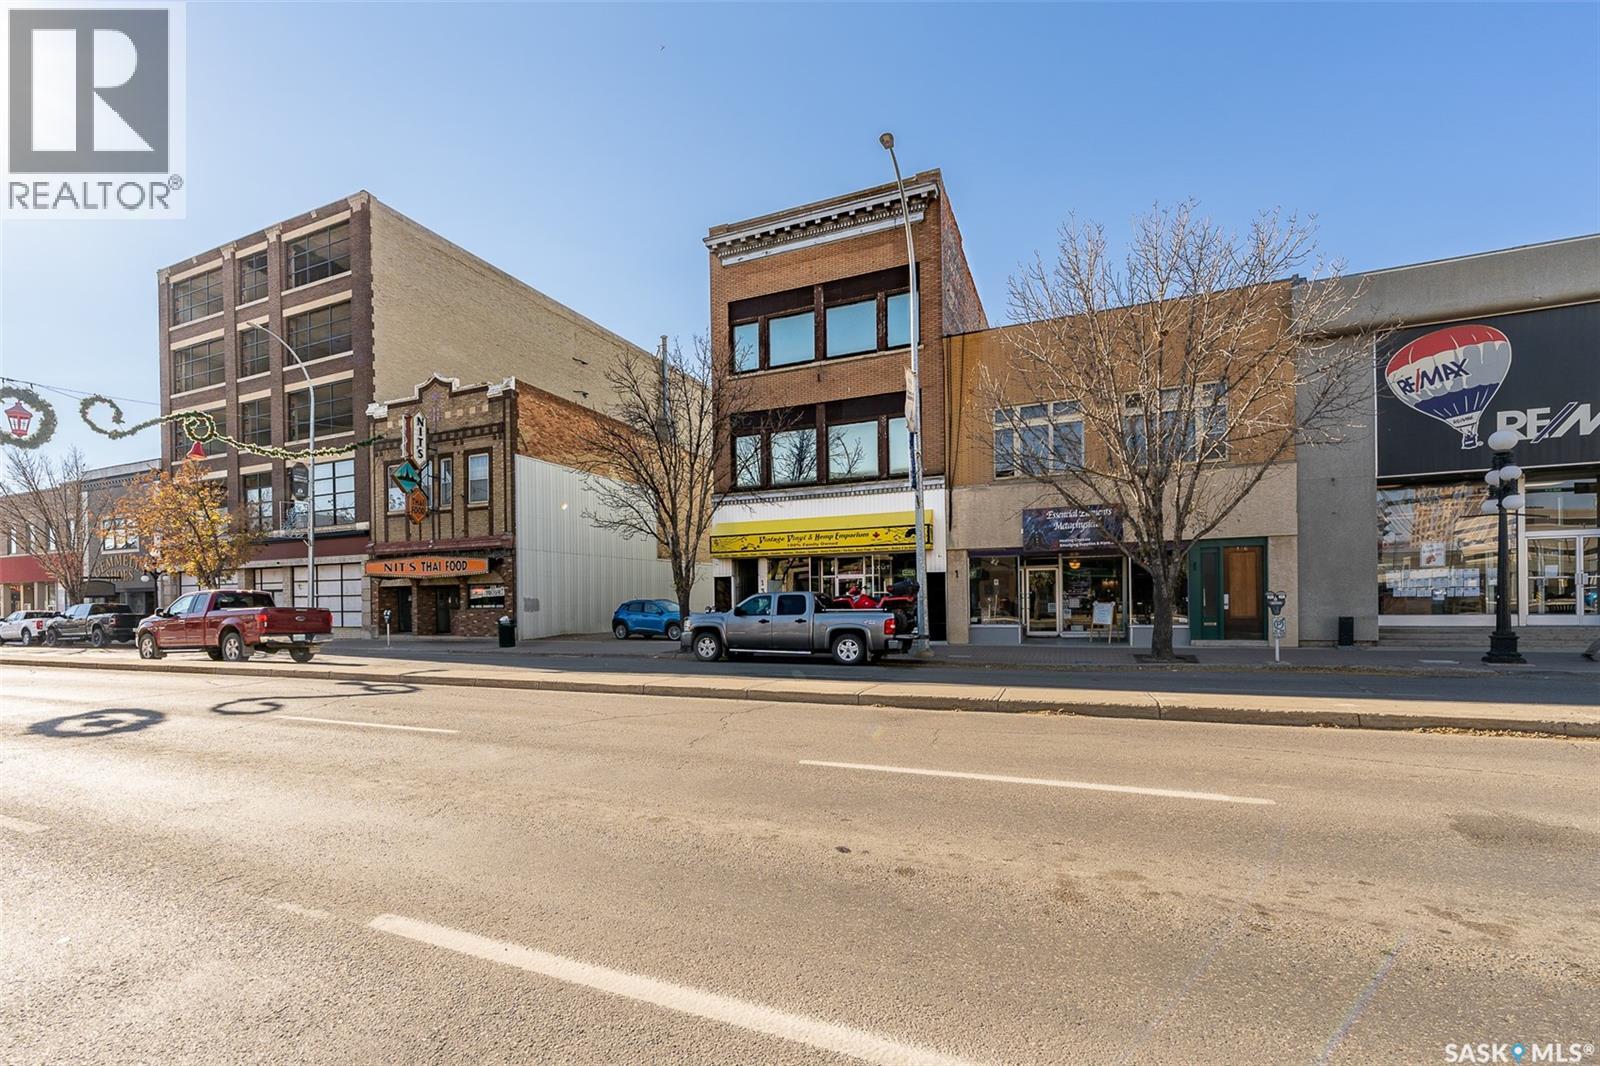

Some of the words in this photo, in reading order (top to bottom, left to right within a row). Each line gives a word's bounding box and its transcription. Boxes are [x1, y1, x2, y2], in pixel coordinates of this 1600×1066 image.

[1396, 358, 1471, 396] RE/MAX
[416, 416, 425, 459] NIT'S
[1046, 509, 1078, 519] Essential
[758, 536, 785, 544] Vintage
[814, 532, 834, 541] Hemp
[384, 562, 417, 573] NIT'S
[421, 561, 442, 572] THAI
[445, 560, 468, 572] FOOD
